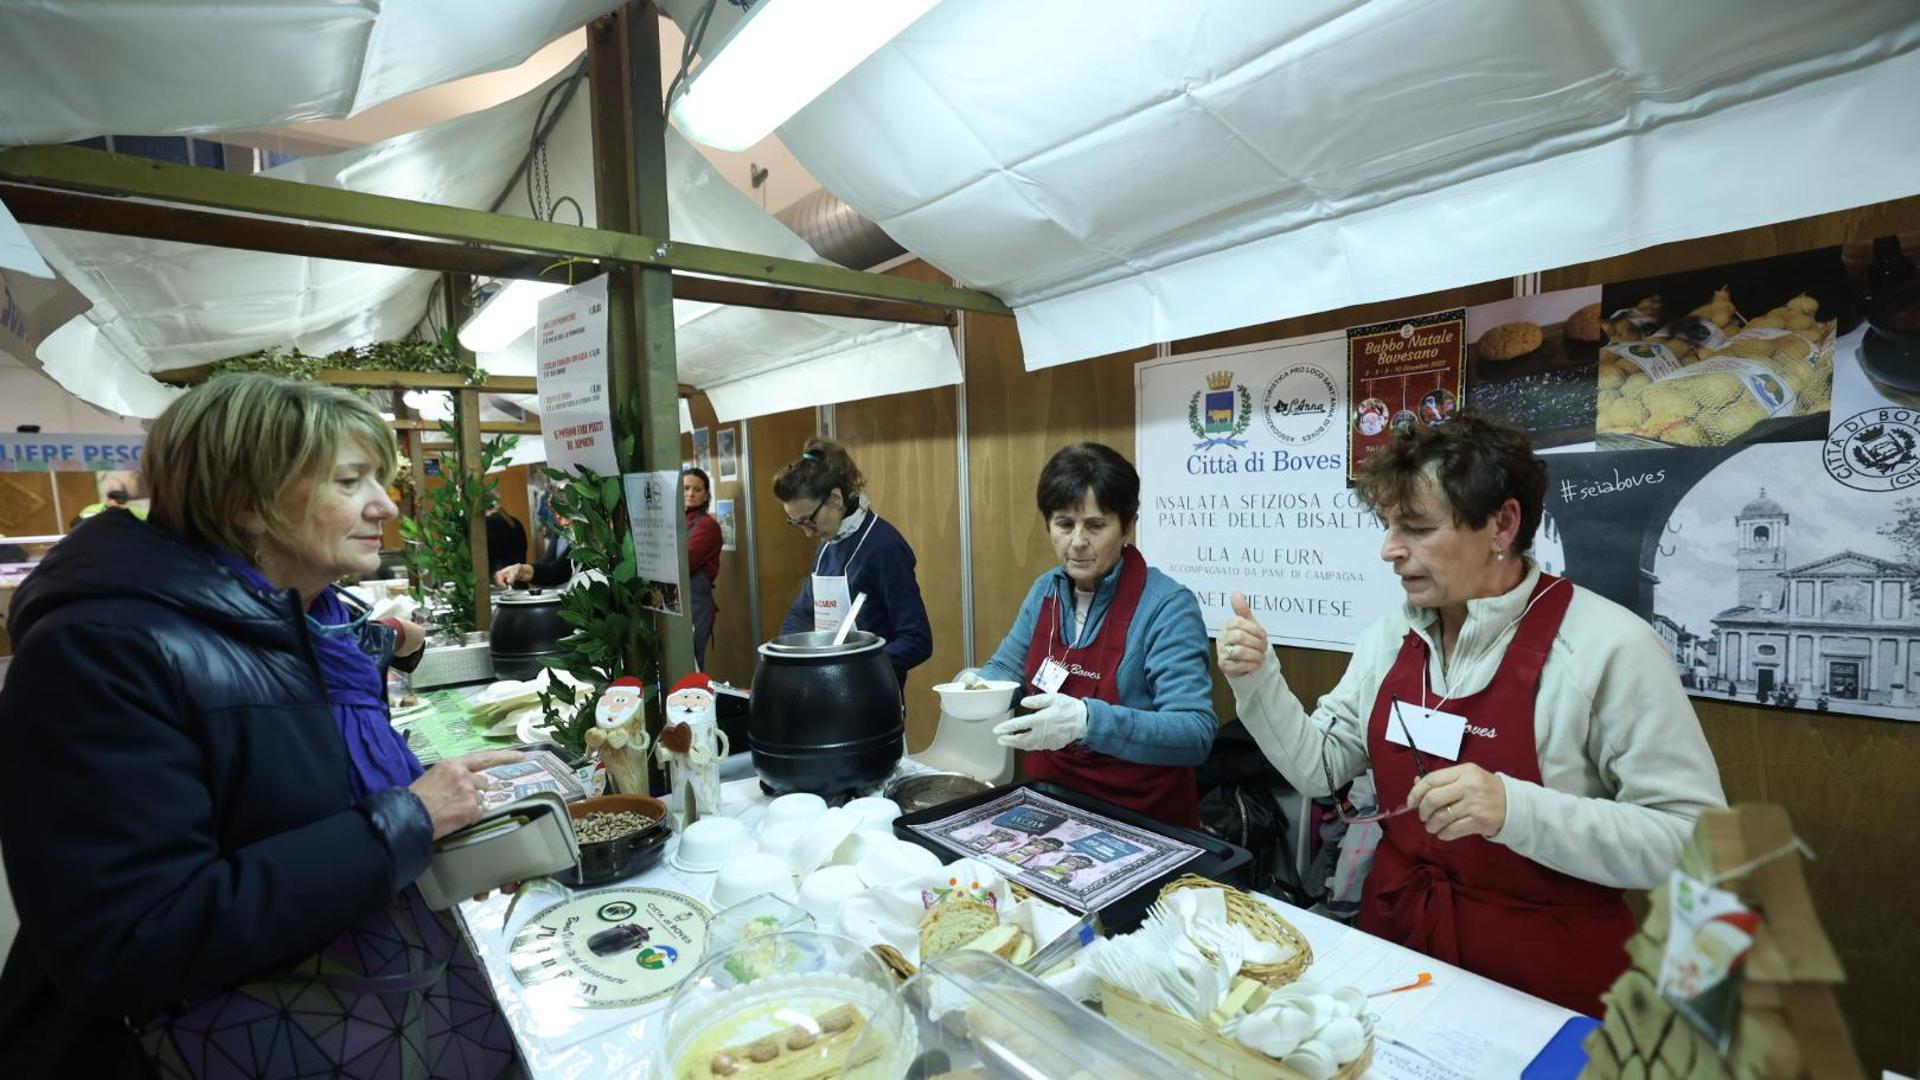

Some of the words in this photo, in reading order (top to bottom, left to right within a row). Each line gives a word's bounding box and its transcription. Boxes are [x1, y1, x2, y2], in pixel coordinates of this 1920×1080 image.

[1364, 339, 1404, 355] Babbo
[1408, 329, 1454, 348] Natale
[1377, 347, 1439, 365] Bovesano
[1290, 366, 1304, 374] PRO
[1305, 366, 1324, 379] LOCO
[1264, 371, 1289, 402] TURISTICA
[1323, 418, 1331, 427] DI
[1844, 416, 1867, 432] DI
[1302, 425, 1325, 442] BOVES
[1187, 455, 1238, 475] Città
[1245, 452, 1264, 472] di
[1273, 450, 1341, 471] Boves
[1560, 468, 1665, 503] #seiaboves
[1156, 495, 1230, 510] INSALATA
[1241, 493, 1321, 509] SFIZIOSA
[1159, 512, 1217, 528] PATATE
[1229, 512, 1285, 528] DELLA
[1297, 512, 1379, 529] BISALTA
[1198, 546, 1230, 562] ULA
[1241, 547, 1264, 563] AU
[1274, 548, 1324, 565] FURN
[1169, 564, 1239, 576] ACCOMPAGNATO
[1244, 567, 1257, 577] DA
[1262, 567, 1285, 577] PANE
[1291, 569, 1301, 579] DI
[1305, 570, 1364, 582] CAMPAGNA
[1248, 593, 1351, 617] IEMONTESE
